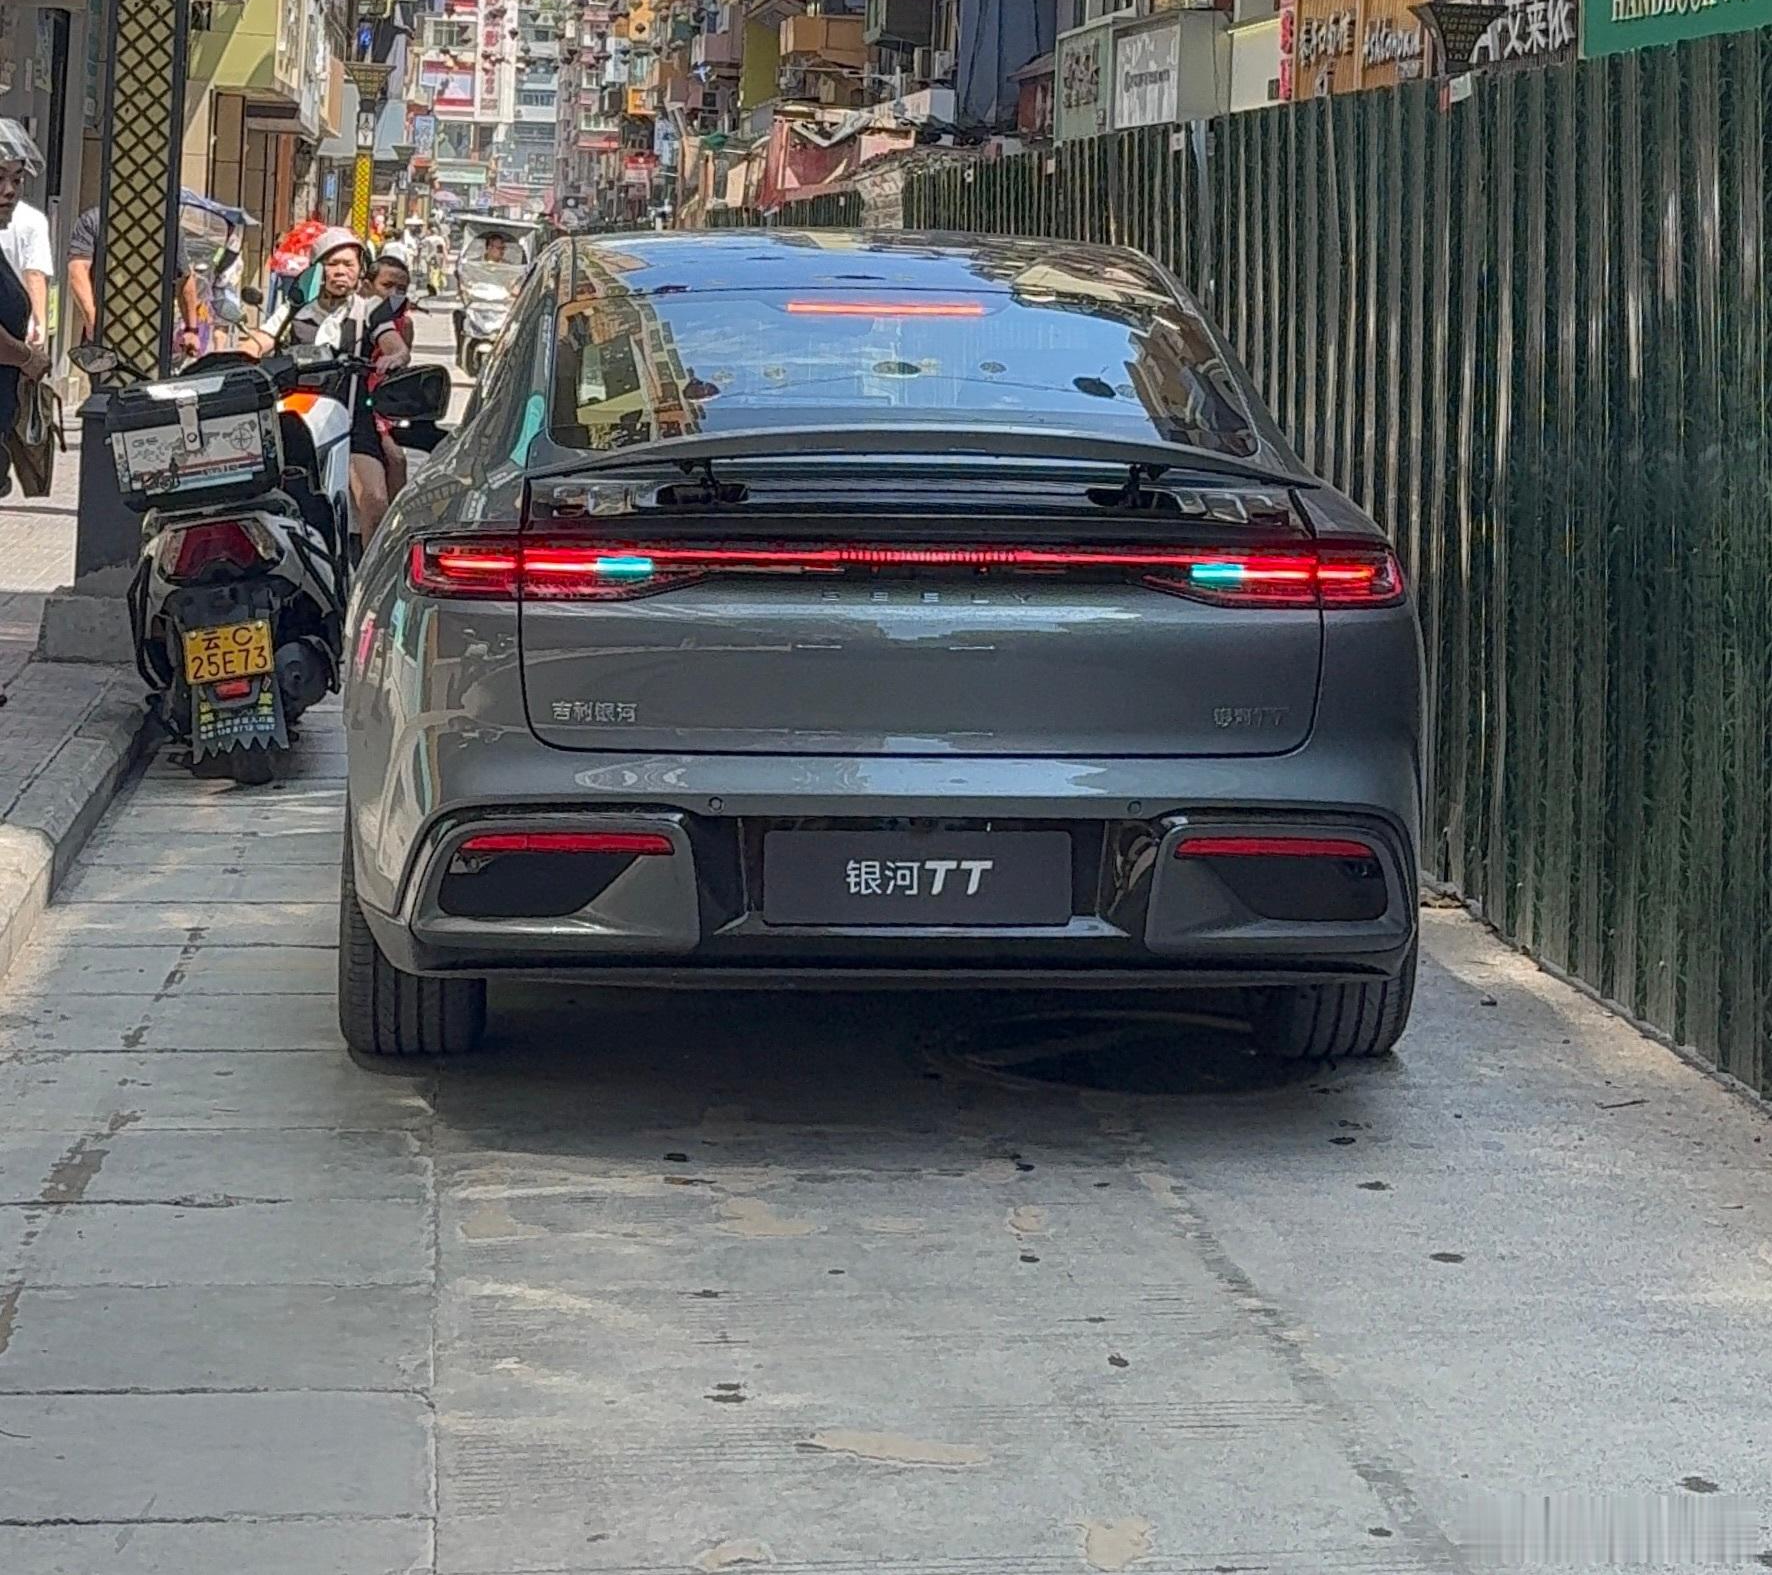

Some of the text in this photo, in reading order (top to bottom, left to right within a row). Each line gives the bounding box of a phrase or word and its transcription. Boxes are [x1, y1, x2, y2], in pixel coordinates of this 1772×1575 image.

[191, 645, 268, 680] 25E73
[551, 701, 637, 722] 吉利银河
